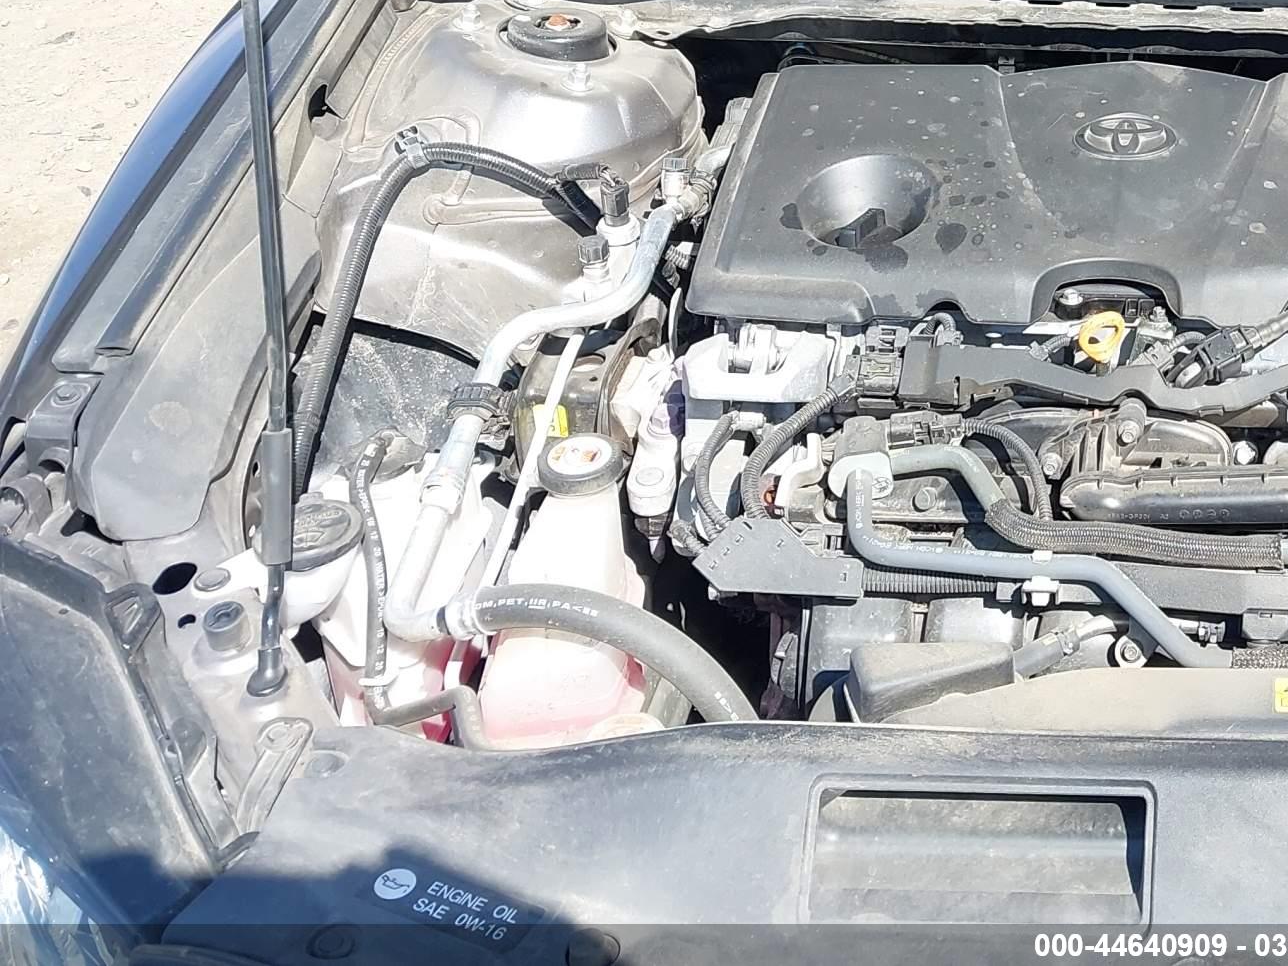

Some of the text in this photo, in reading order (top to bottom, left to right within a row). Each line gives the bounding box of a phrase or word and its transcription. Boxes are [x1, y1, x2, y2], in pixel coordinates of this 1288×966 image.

[412, 898, 507, 940] SAE 0W-16
[427, 881, 518, 924] ENGINE OIL
